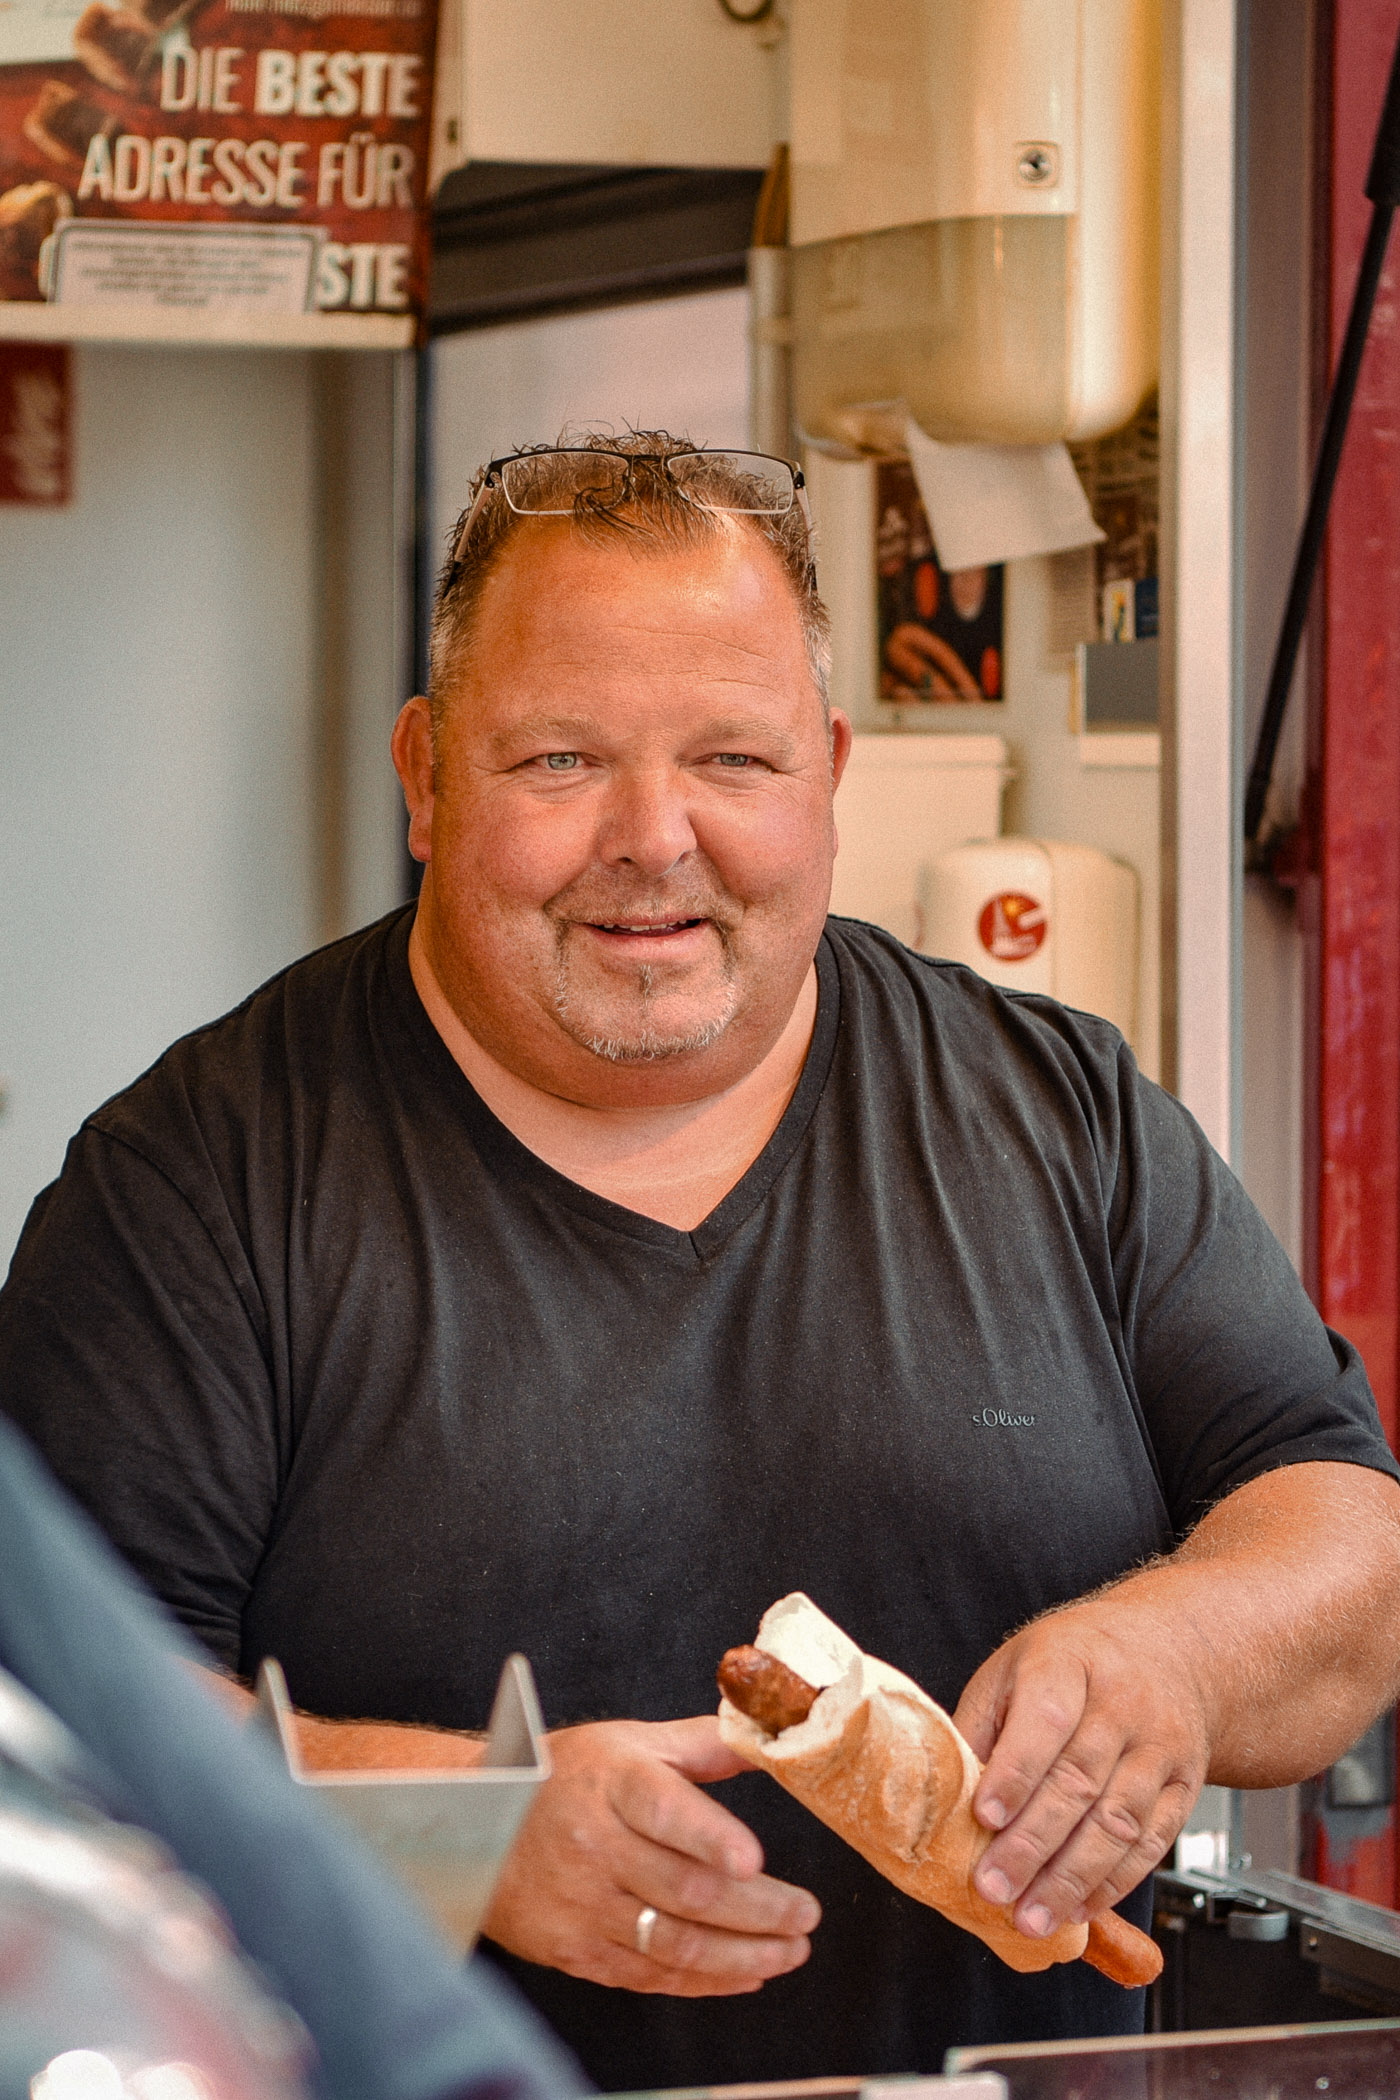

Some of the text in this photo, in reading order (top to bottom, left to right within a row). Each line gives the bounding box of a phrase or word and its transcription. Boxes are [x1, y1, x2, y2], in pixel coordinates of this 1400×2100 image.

[160, 47, 421, 117] DIE BESTE
[77, 132, 416, 209] ADRESSE FÜR
